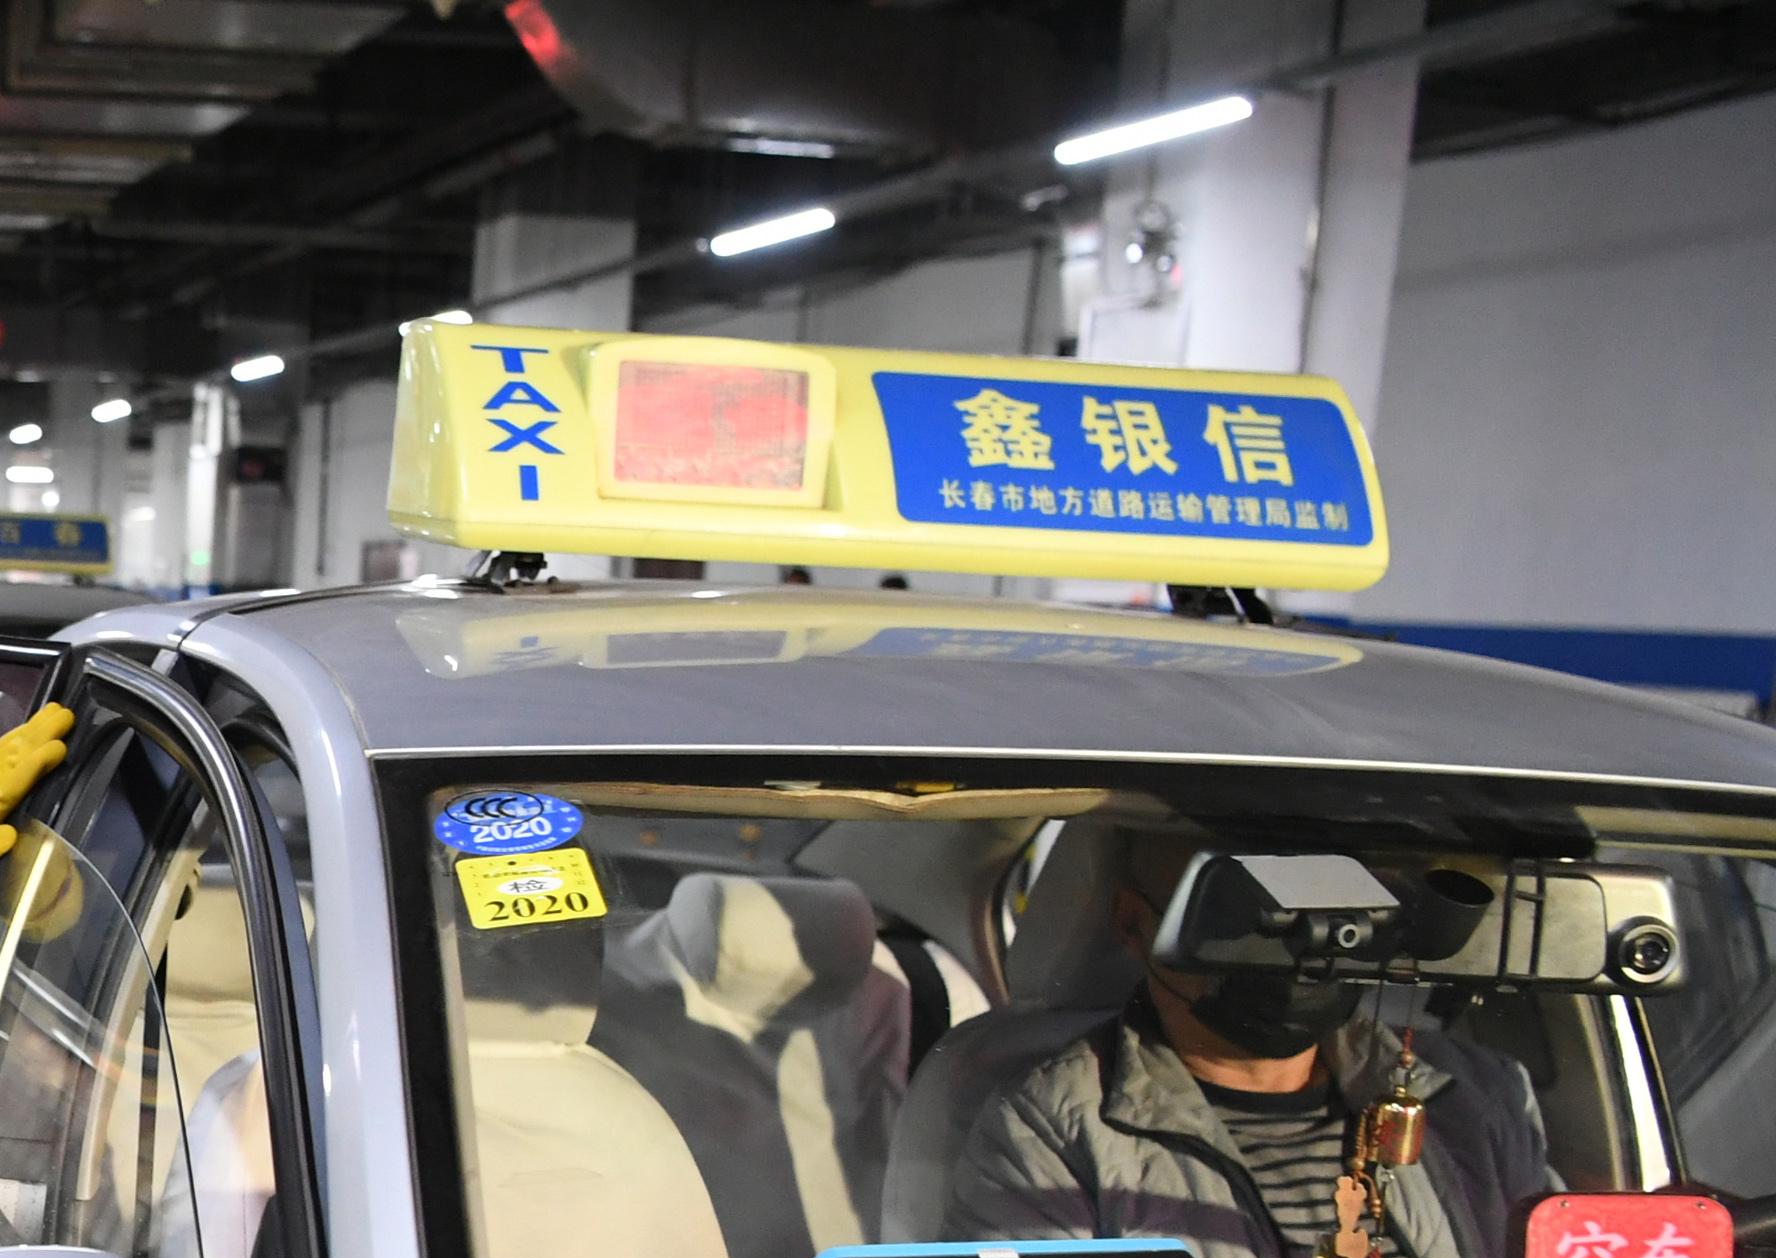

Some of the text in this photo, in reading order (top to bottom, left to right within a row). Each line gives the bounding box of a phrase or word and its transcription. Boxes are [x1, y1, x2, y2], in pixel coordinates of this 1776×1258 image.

[470, 345, 565, 501] TAXI
[954, 388, 1294, 487] 鑫银信
[939, 478, 1349, 532] 长春市地方道路运输管理局监制
[470, 817, 552, 843] 2020
[485, 892, 589, 921] 2020
